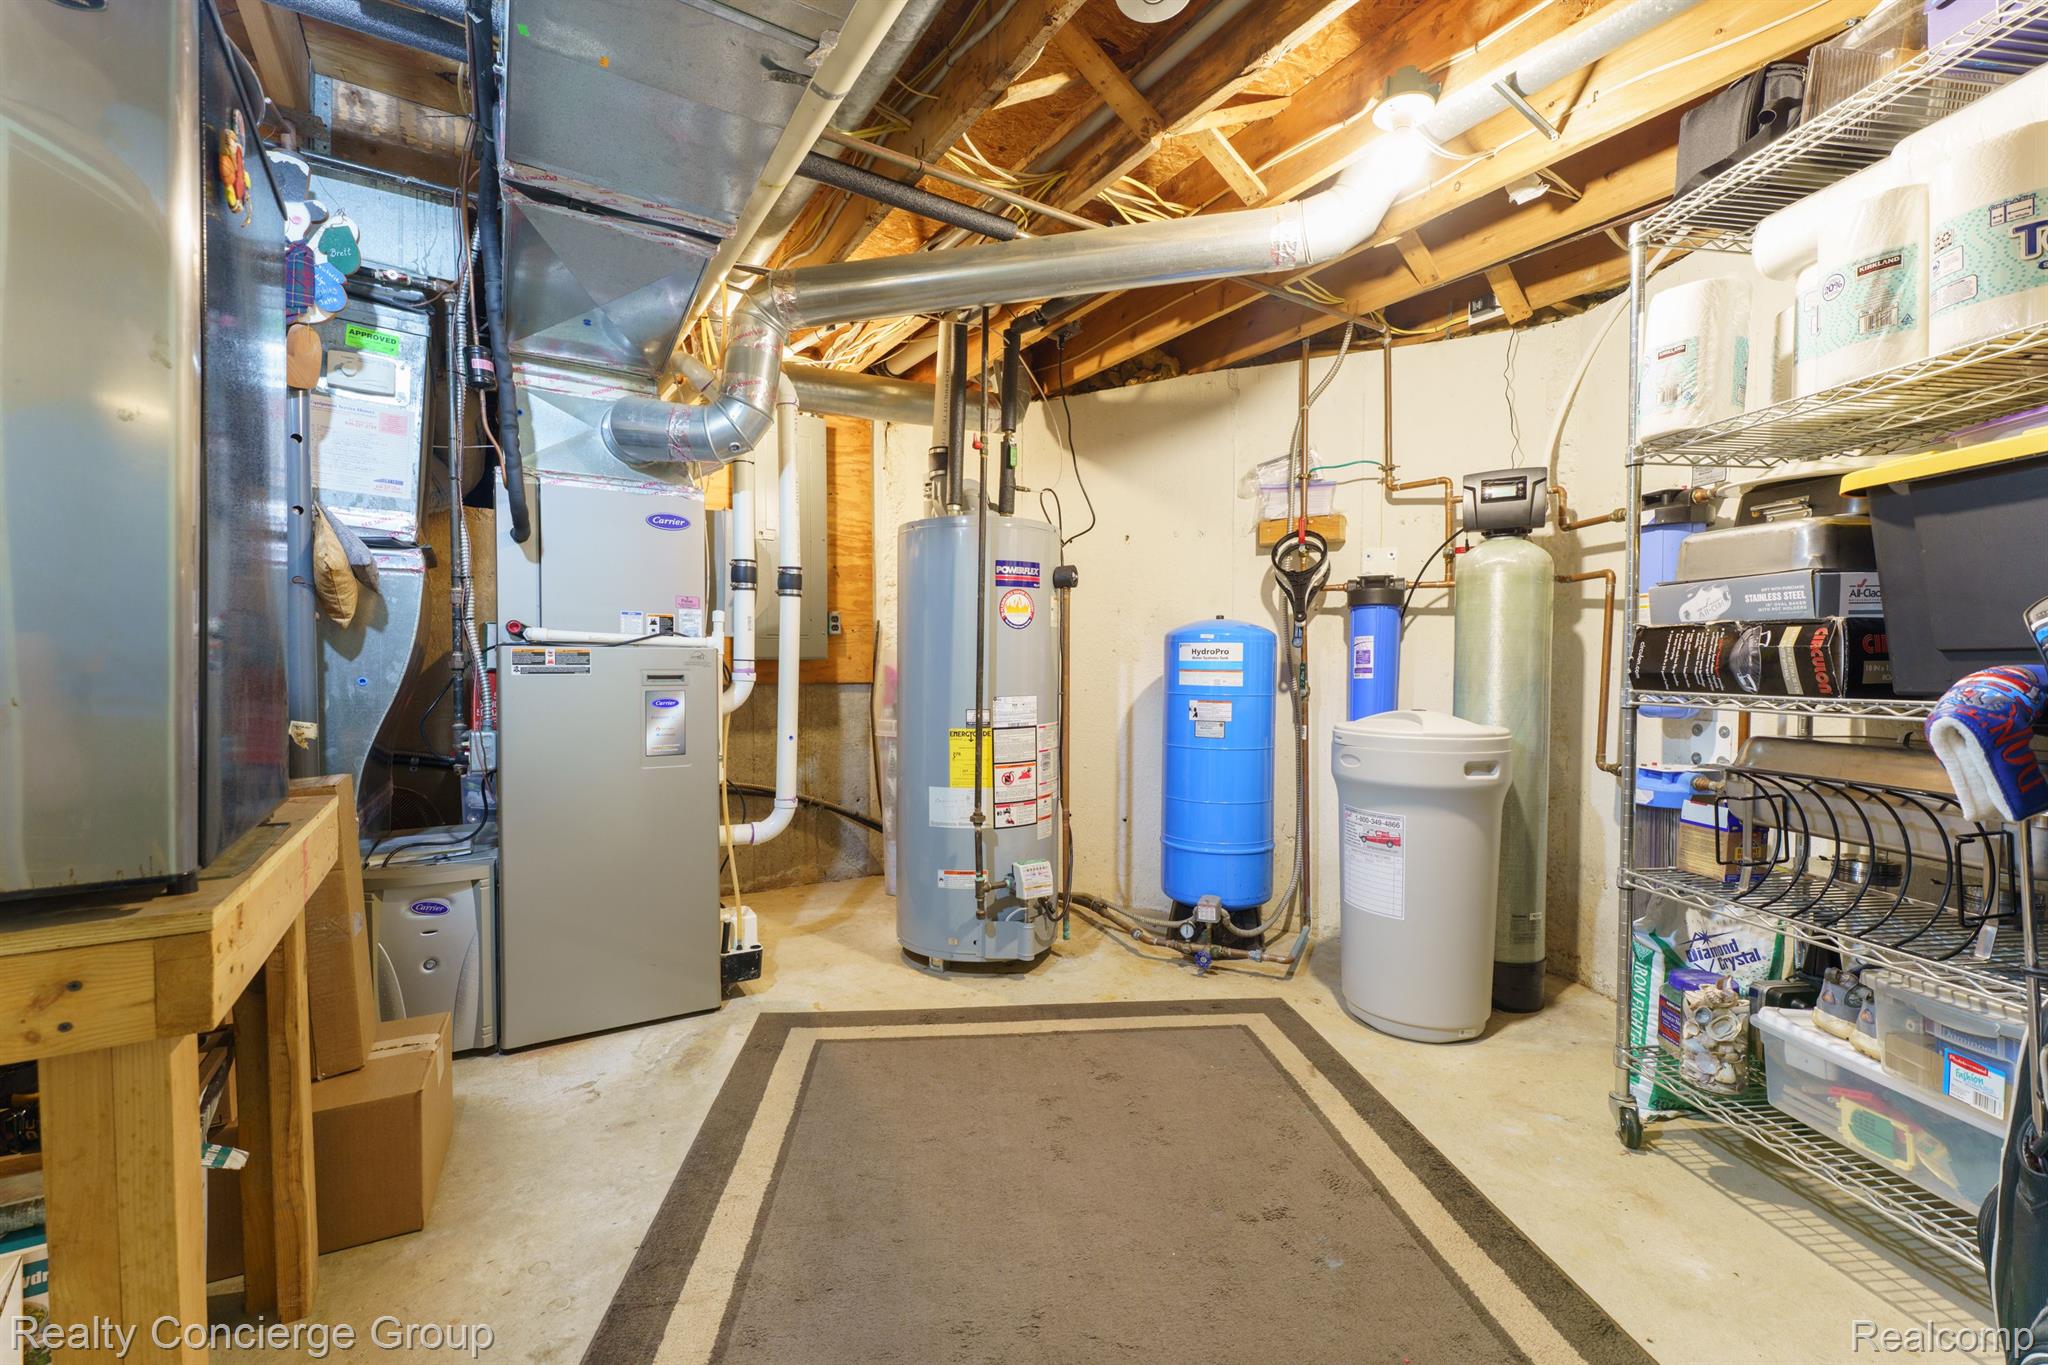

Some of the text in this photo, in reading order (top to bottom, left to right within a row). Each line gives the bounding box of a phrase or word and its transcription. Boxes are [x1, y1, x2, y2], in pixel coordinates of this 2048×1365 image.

[330, 247, 352, 257] Brett
[1859, 256, 1900, 273] KIRKLAND
[349, 328, 397, 345] APPROVED
[653, 516, 686, 526] Carrier
[996, 565, 1039, 576] POWERFLEX
[1744, 590, 1807, 603] STAINLESS STEEL
[1191, 648, 1230, 656] HydroPro
[1634, 641, 1646, 679] circulon.com
[1355, 815, 1401, 829] 1-800-349-4866
[1686, 938, 1740, 962] Diamond
[1718, 947, 1762, 971] Crystal
[1633, 961, 1648, 997] IRON
